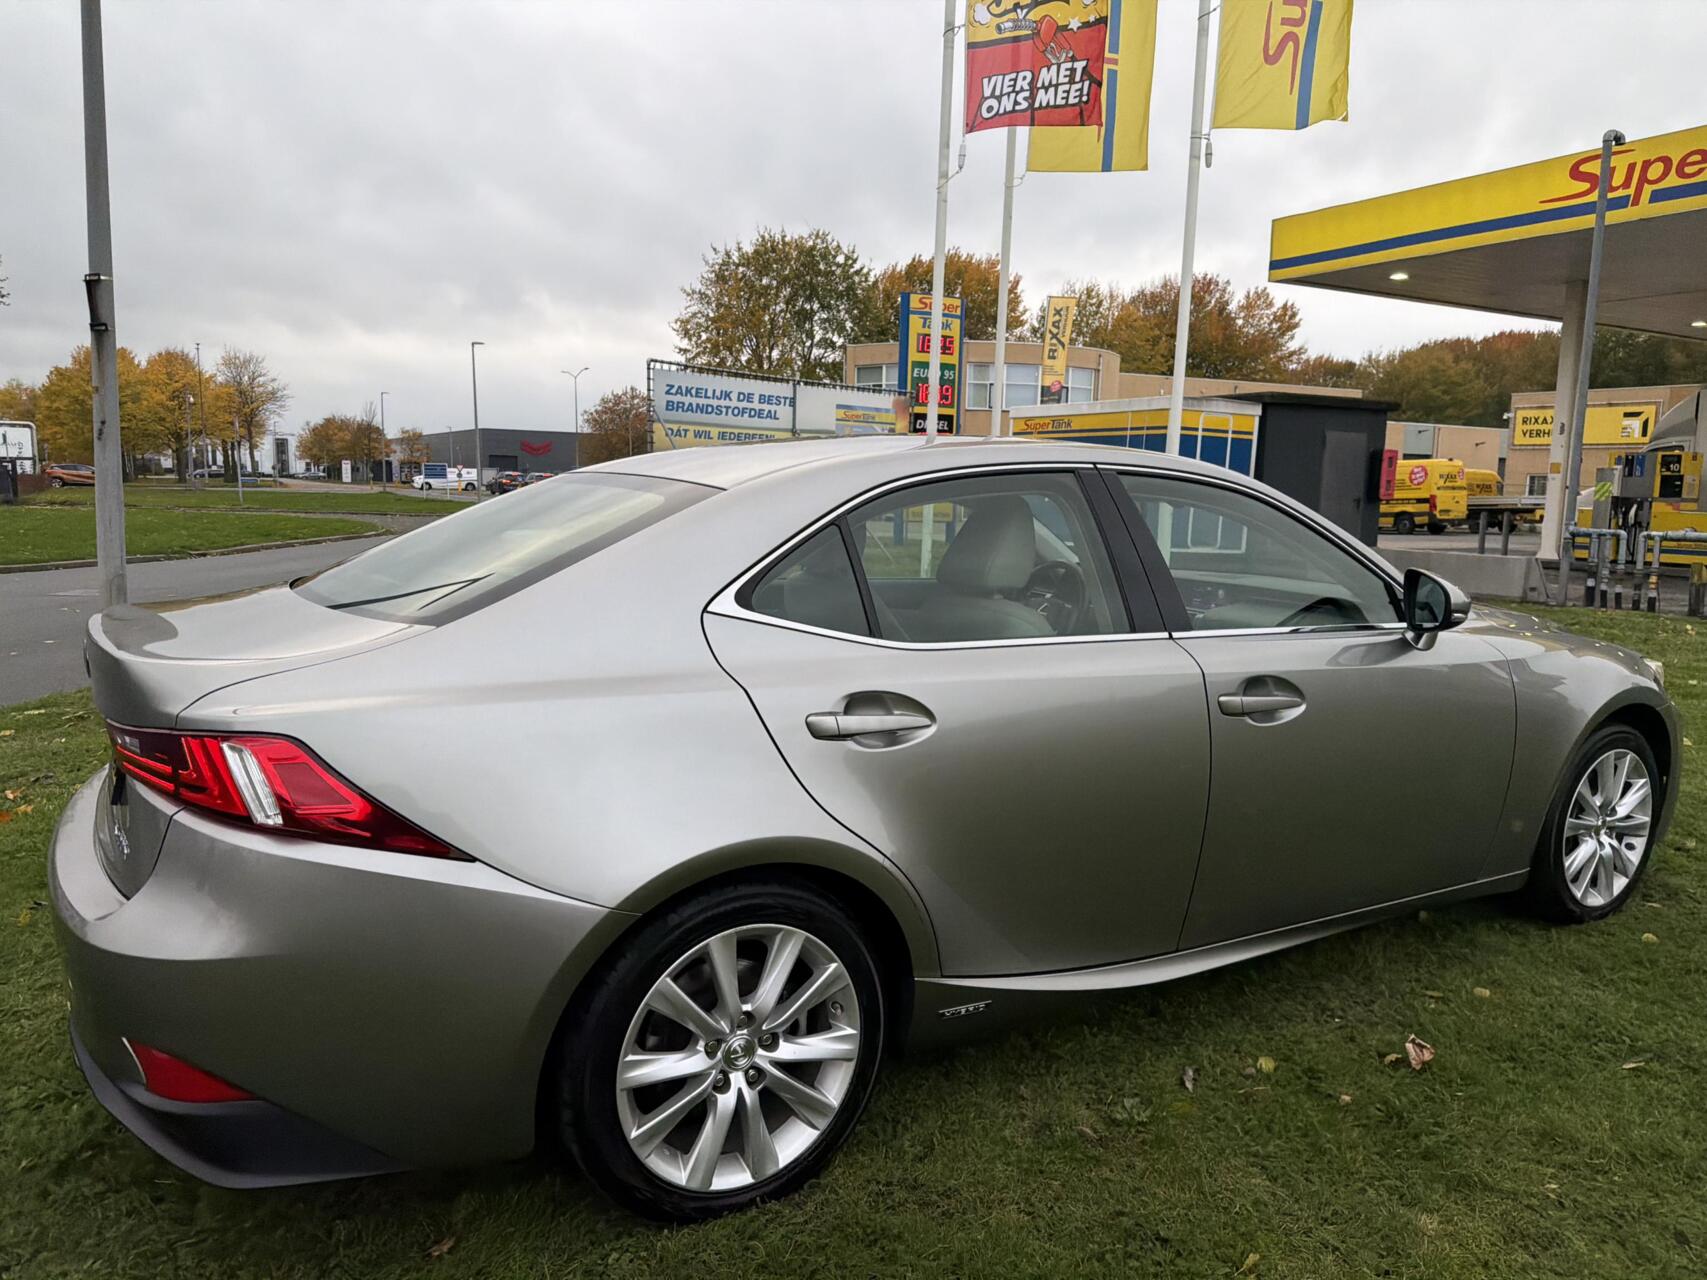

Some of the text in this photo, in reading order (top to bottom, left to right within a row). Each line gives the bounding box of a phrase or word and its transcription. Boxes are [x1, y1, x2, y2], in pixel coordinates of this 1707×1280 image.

[982, 60, 1088, 98] VIER MET
[981, 80, 1090, 119] ONS MEE!
[943, 369, 955, 380] 95
[665, 384, 795, 407] ZAKELIJK DE BESTE
[665, 400, 780, 420] BRANDSTOFDEAL
[1020, 418, 1073, 434] SuperTank
[1521, 428, 1553, 438] VERH
[693, 429, 713, 440] WIL
[1670, 463, 1680, 471] 10
